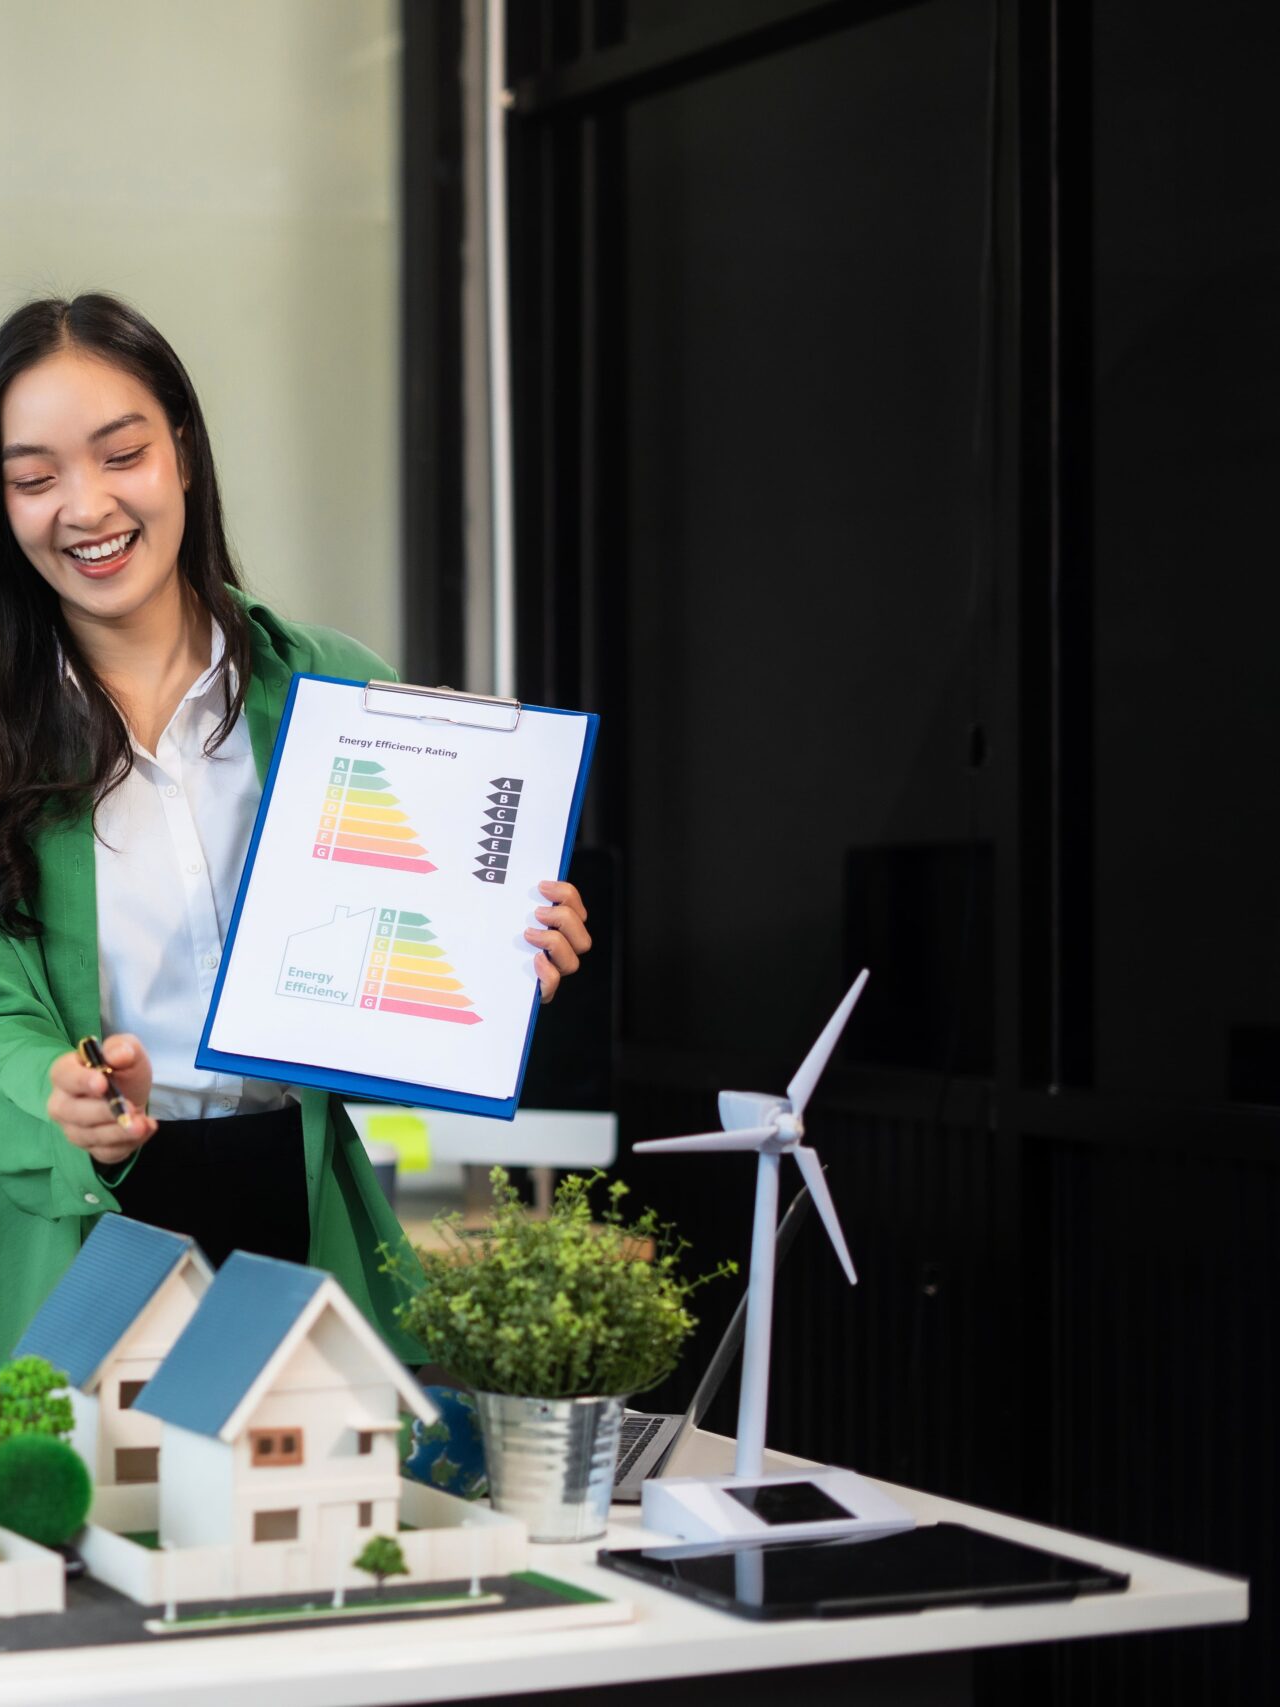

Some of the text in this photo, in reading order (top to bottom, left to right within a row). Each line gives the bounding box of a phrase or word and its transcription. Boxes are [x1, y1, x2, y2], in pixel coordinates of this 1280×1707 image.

[338, 735, 458, 760] Energy Efficiency Rating
[336, 760, 345, 770] A
[333, 774, 342, 784] B
[502, 780, 511, 789] A
[330, 789, 339, 798] C
[499, 794, 508, 804] B
[496, 809, 506, 819] C
[324, 818, 332, 827] E
[493, 825, 504, 835] D
[320, 833, 328, 841] F
[490, 841, 499, 850] E
[317, 847, 326, 857] G
[487, 856, 496, 865] F
[485, 871, 495, 881] G
[383, 912, 392, 921] A
[381, 926, 389, 935] B
[377, 940, 386, 949] C
[374, 955, 383, 964] D
[288, 966, 334, 985] Energy
[284, 980, 349, 1001] Efficiency
[367, 983, 375, 992] F
[364, 998, 374, 1007] G
